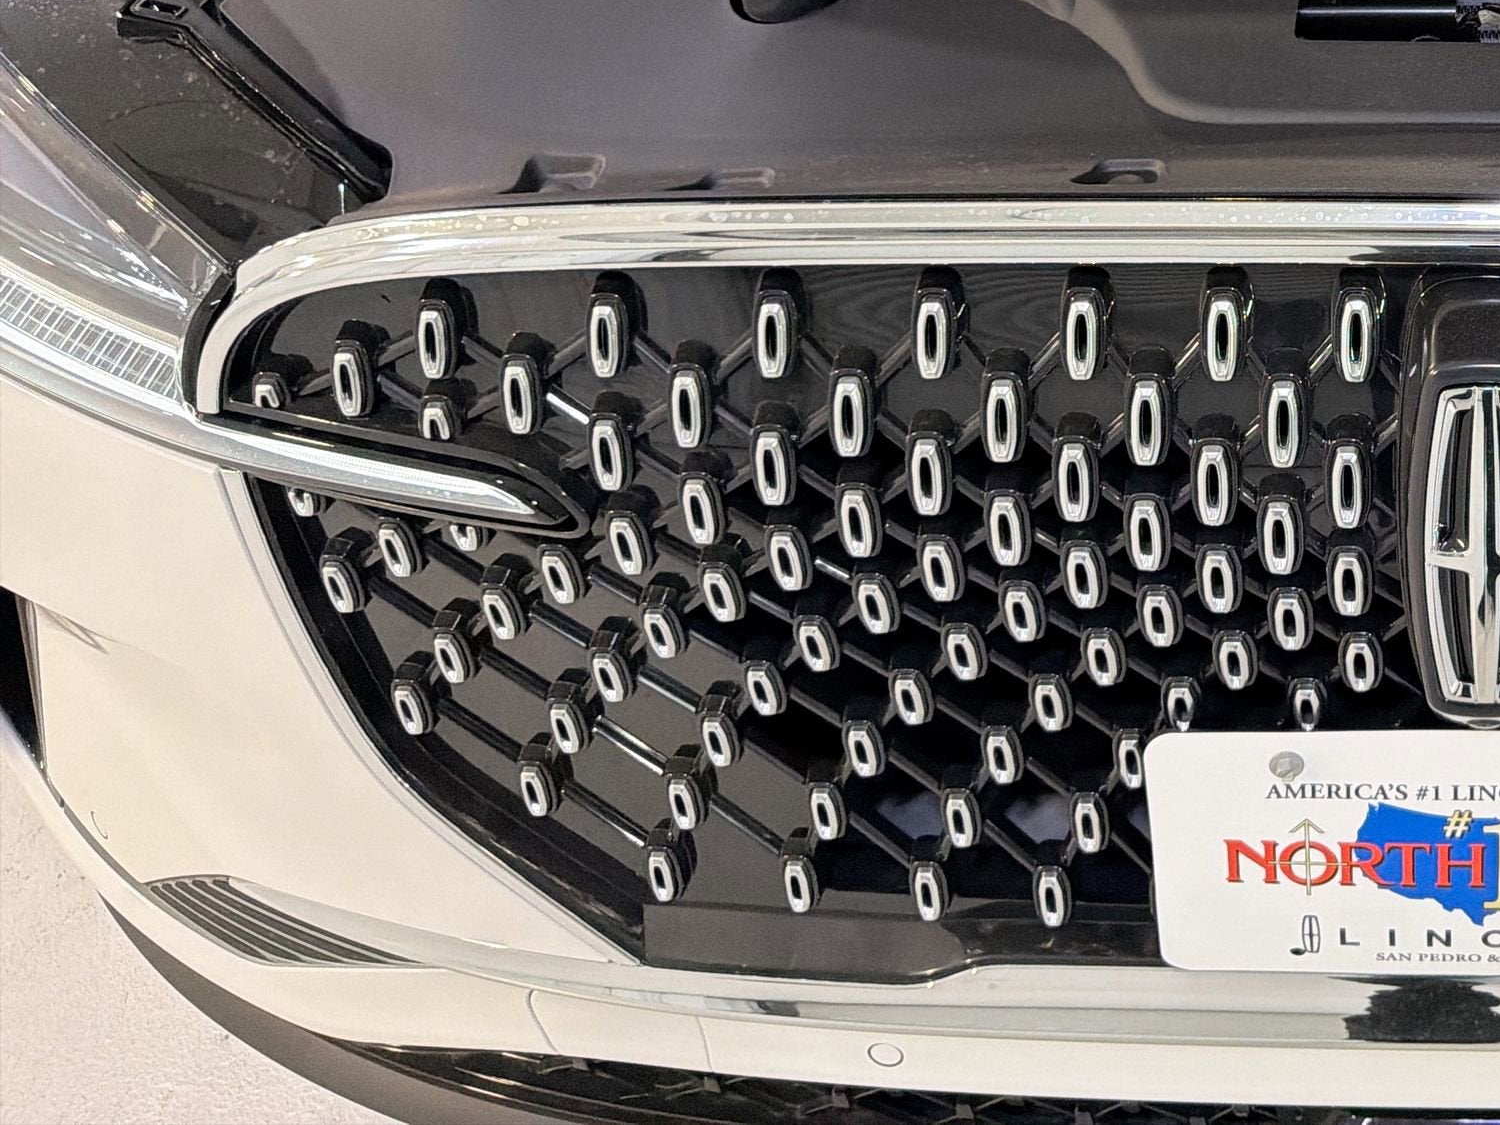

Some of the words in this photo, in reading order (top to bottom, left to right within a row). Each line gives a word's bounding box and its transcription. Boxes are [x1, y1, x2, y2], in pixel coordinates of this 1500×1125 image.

[1265, 783, 1408, 801] AMERICA'S
[1416, 785, 1442, 801] #1
[1223, 839, 1486, 888] NORTH
[1375, 952, 1413, 962] SAN
[1418, 953, 1482, 963] PEDRO
